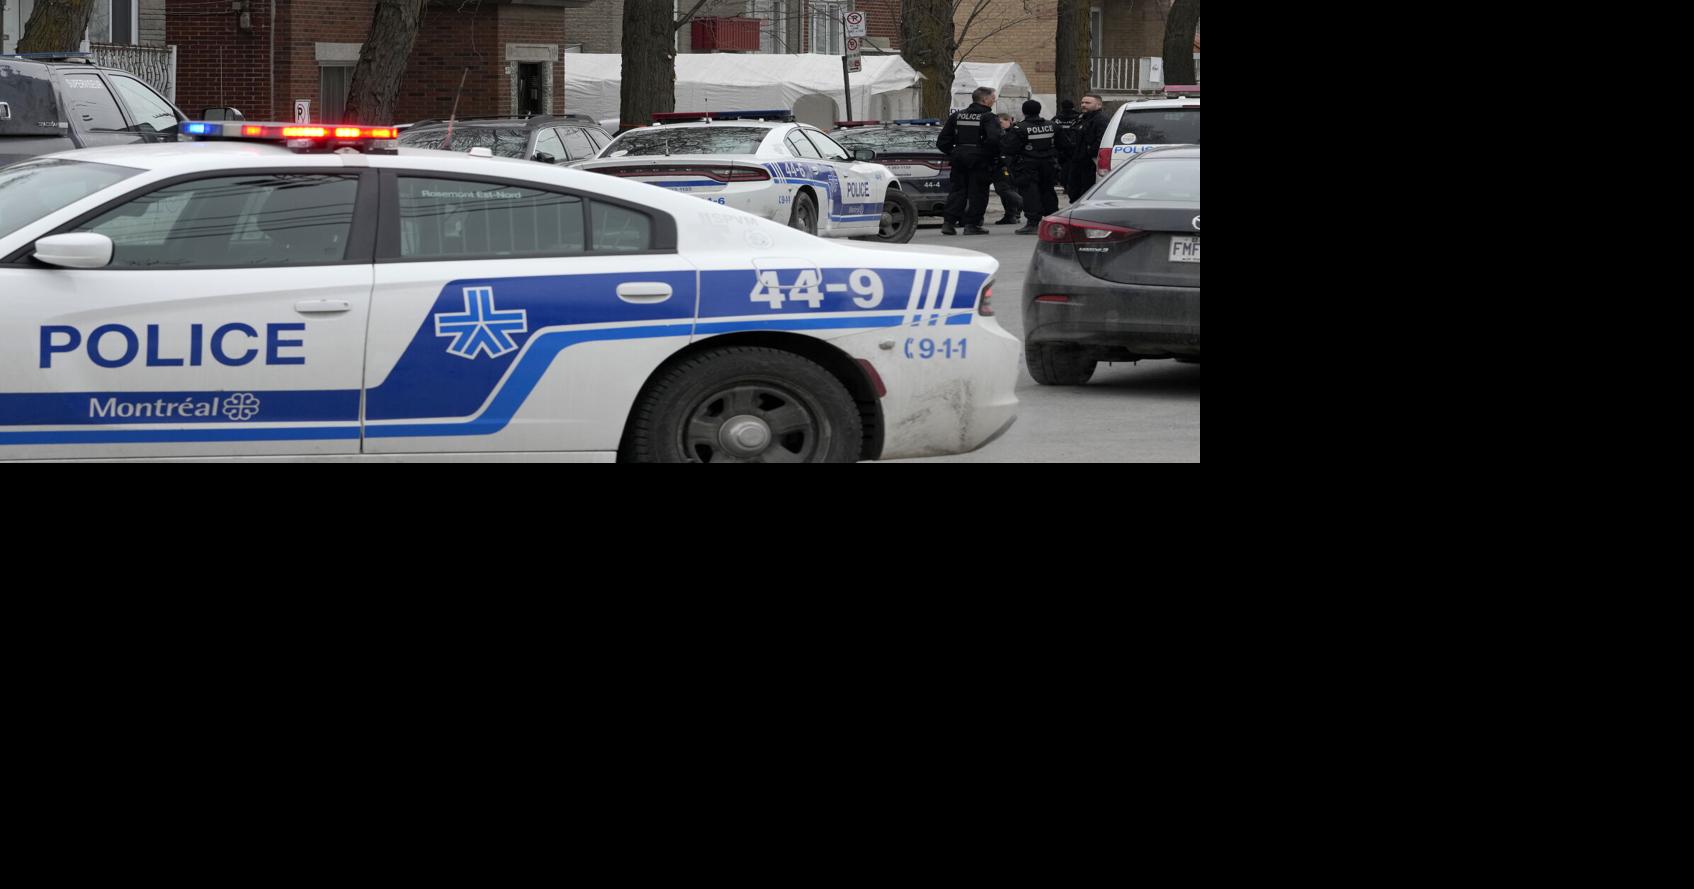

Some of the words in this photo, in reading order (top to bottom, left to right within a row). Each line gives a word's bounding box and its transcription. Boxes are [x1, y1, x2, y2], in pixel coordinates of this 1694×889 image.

[1026, 125, 1054, 134] POLICE
[784, 162, 806, 177] 44-6
[421, 190, 474, 198] Rosemont
[476, 191, 522, 199] Est-Nord
[847, 182, 870, 198] POLICE
[750, 268, 884, 310] 44-9
[39, 322, 306, 369] POLICE
[918, 337, 968, 359] 9-1-1
[88, 396, 220, 419] Montréal
